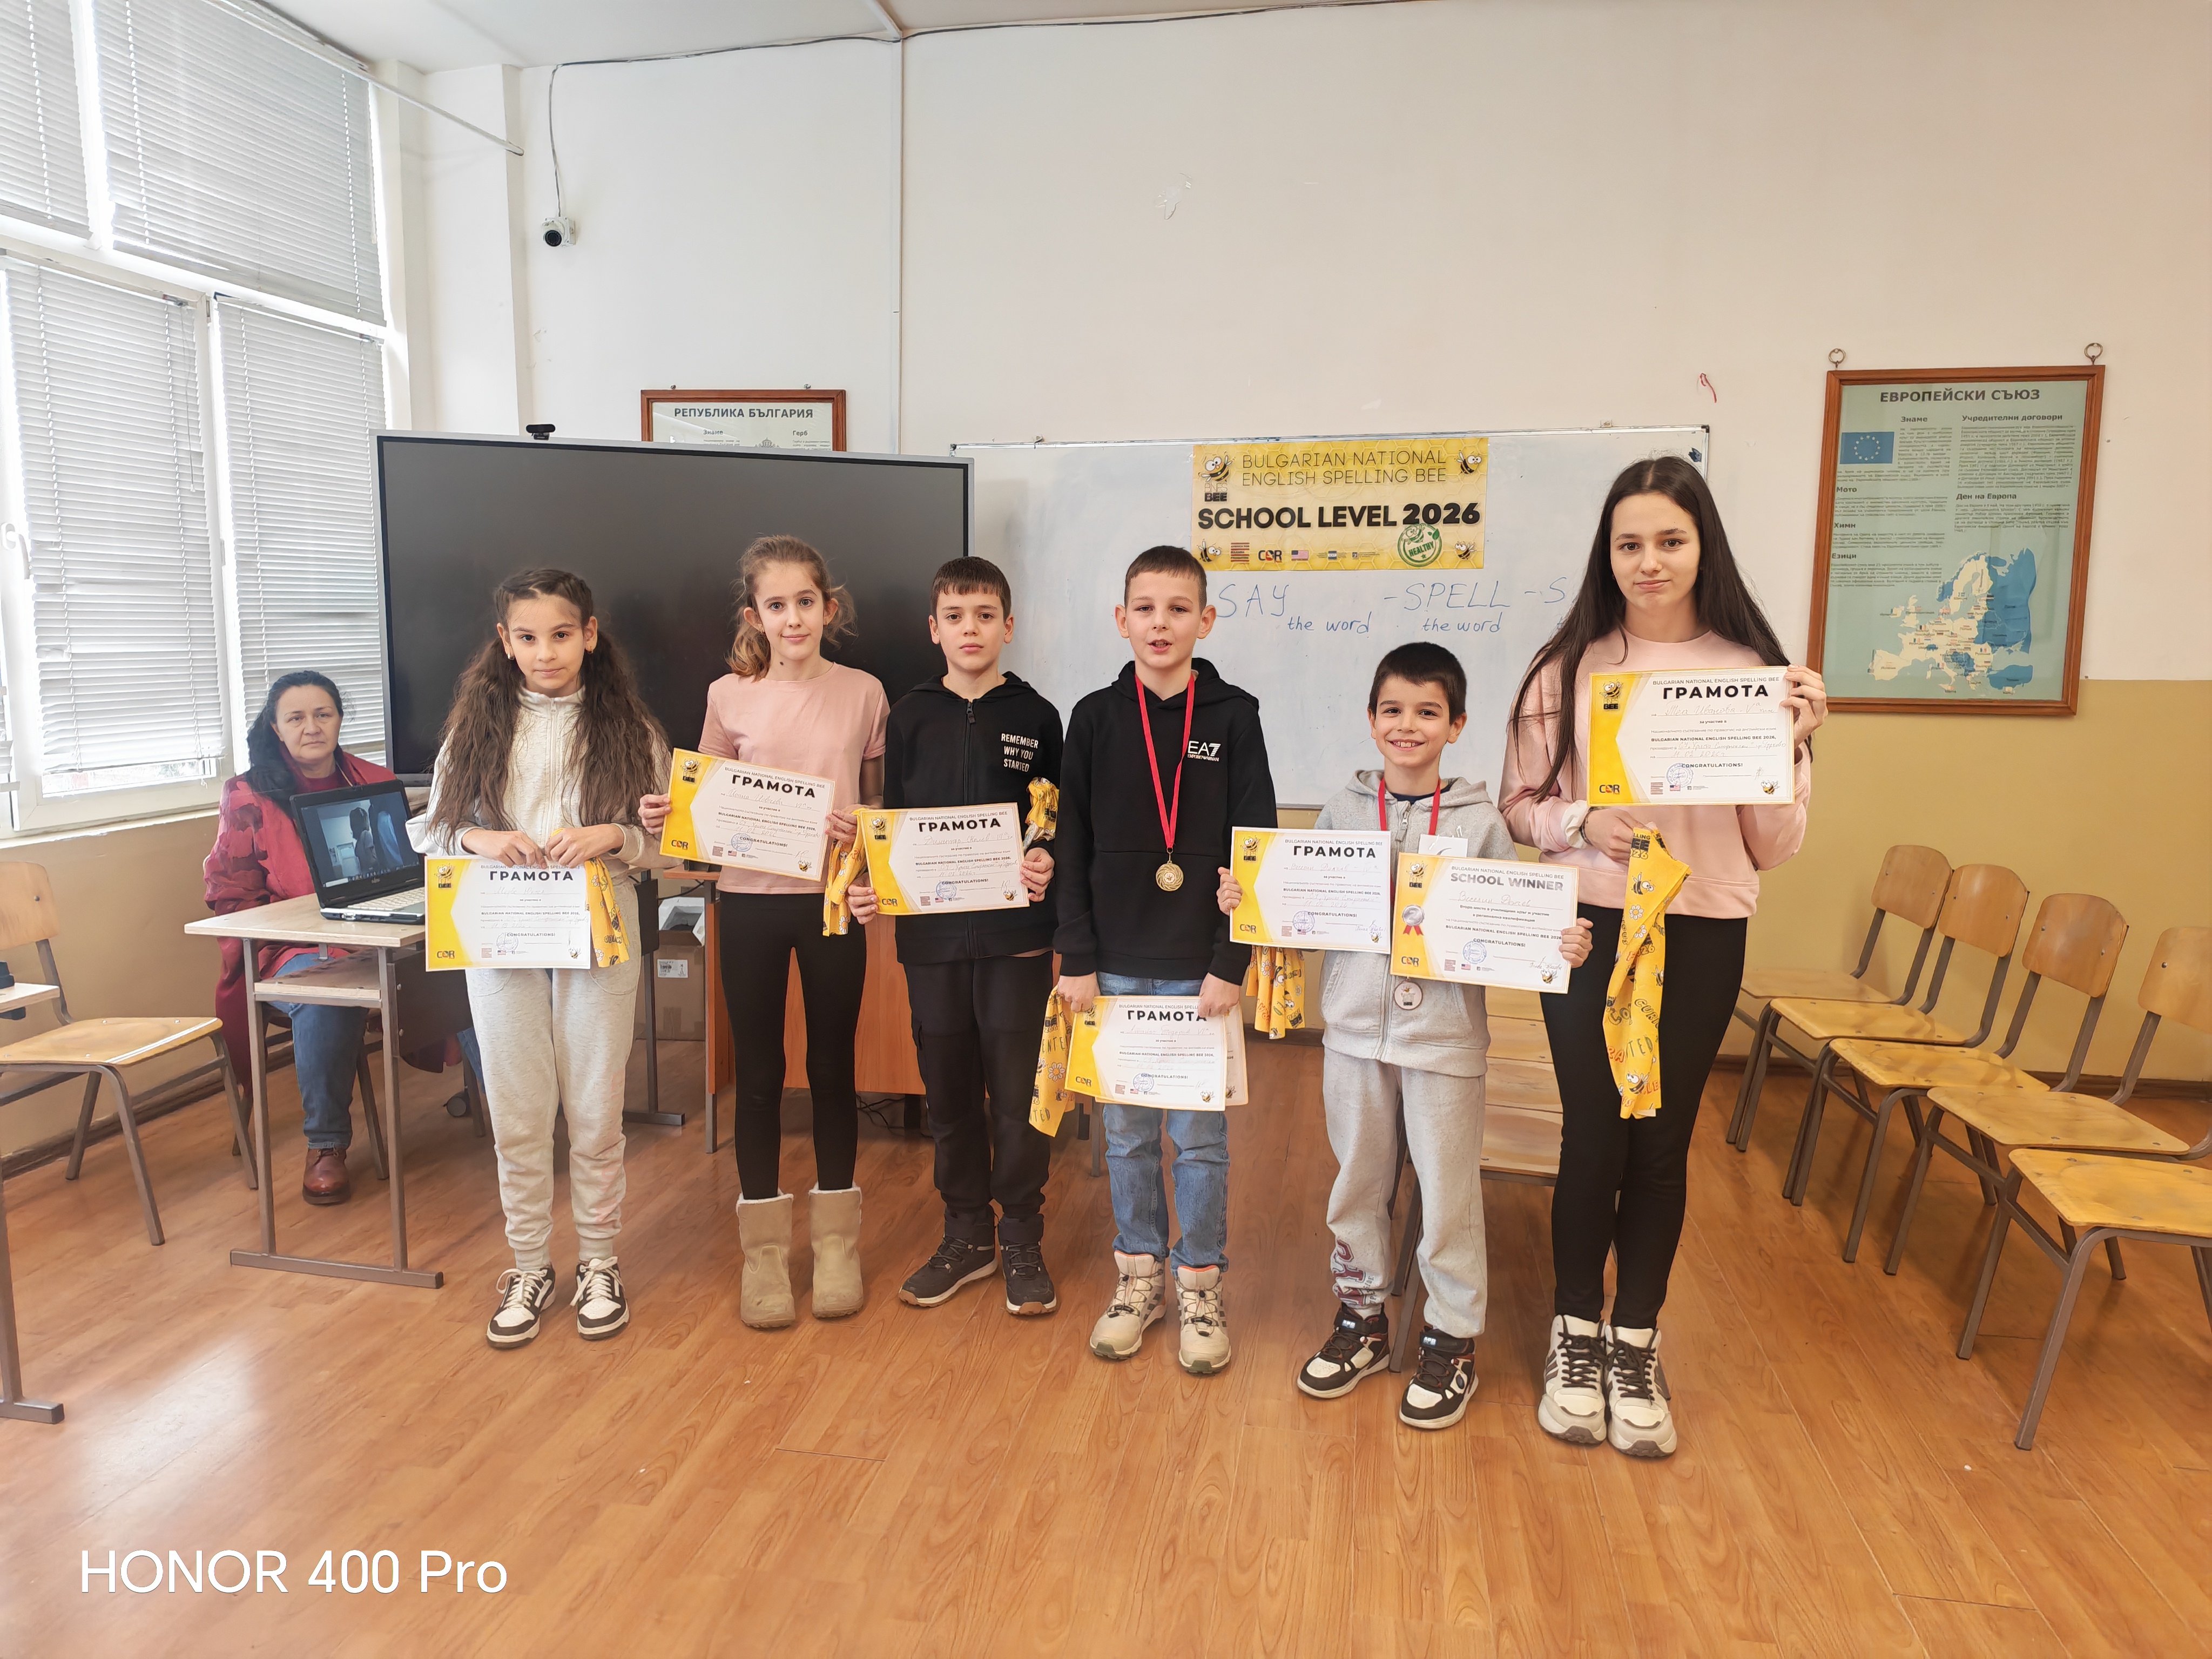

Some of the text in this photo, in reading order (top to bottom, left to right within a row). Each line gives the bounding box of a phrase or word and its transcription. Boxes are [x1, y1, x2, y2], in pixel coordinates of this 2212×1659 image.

[1880, 387, 2040, 402] ЕВРОПЕЙСКИ СЪЮЗ
[674, 408, 813, 418] РЕПУБЛИКА БЪЛГАРИЯ
[1961, 414, 2063, 423] Учредителни договори
[1243, 449, 1445, 469] BULGARIAN NATIONAL
[1243, 467, 1447, 487] ENGLISH SPELLING BEE
[1204, 492, 1228, 502] BEE
[1198, 502, 1481, 530] SCHOOL LEVEL 2026
[1408, 542, 1434, 557] HEALTHY
[1217, 583, 1289, 618] SAY
[1288, 611, 1372, 634] the word
[1422, 611, 1501, 633] the word
[1663, 684, 1768, 699] ГРАМОТА
[1001, 733, 1038, 749] REMEMBER
[1188, 740, 1221, 757] EA7
[1004, 746, 1034, 760] WHY YOU
[725, 766, 750, 775] BULGARIAN
[751, 771, 773, 779] NATIONAL
[1003, 758, 1030, 773] STARTED
[731, 772, 816, 799] ГРАМОТА
[918, 818, 1001, 832] ГРАМОТА
[739, 835, 787, 847] CONGRATULATIONS!
[1293, 845, 1375, 859] ГРАМОТА
[490, 871, 573, 880] ГРАМОТА
[1450, 872, 1563, 891] SCHOOL WINNER
[1473, 938, 1526, 947] CONGRATULATIONS!
[1141, 1071, 1188, 1082] CONGRATULATIONS!
